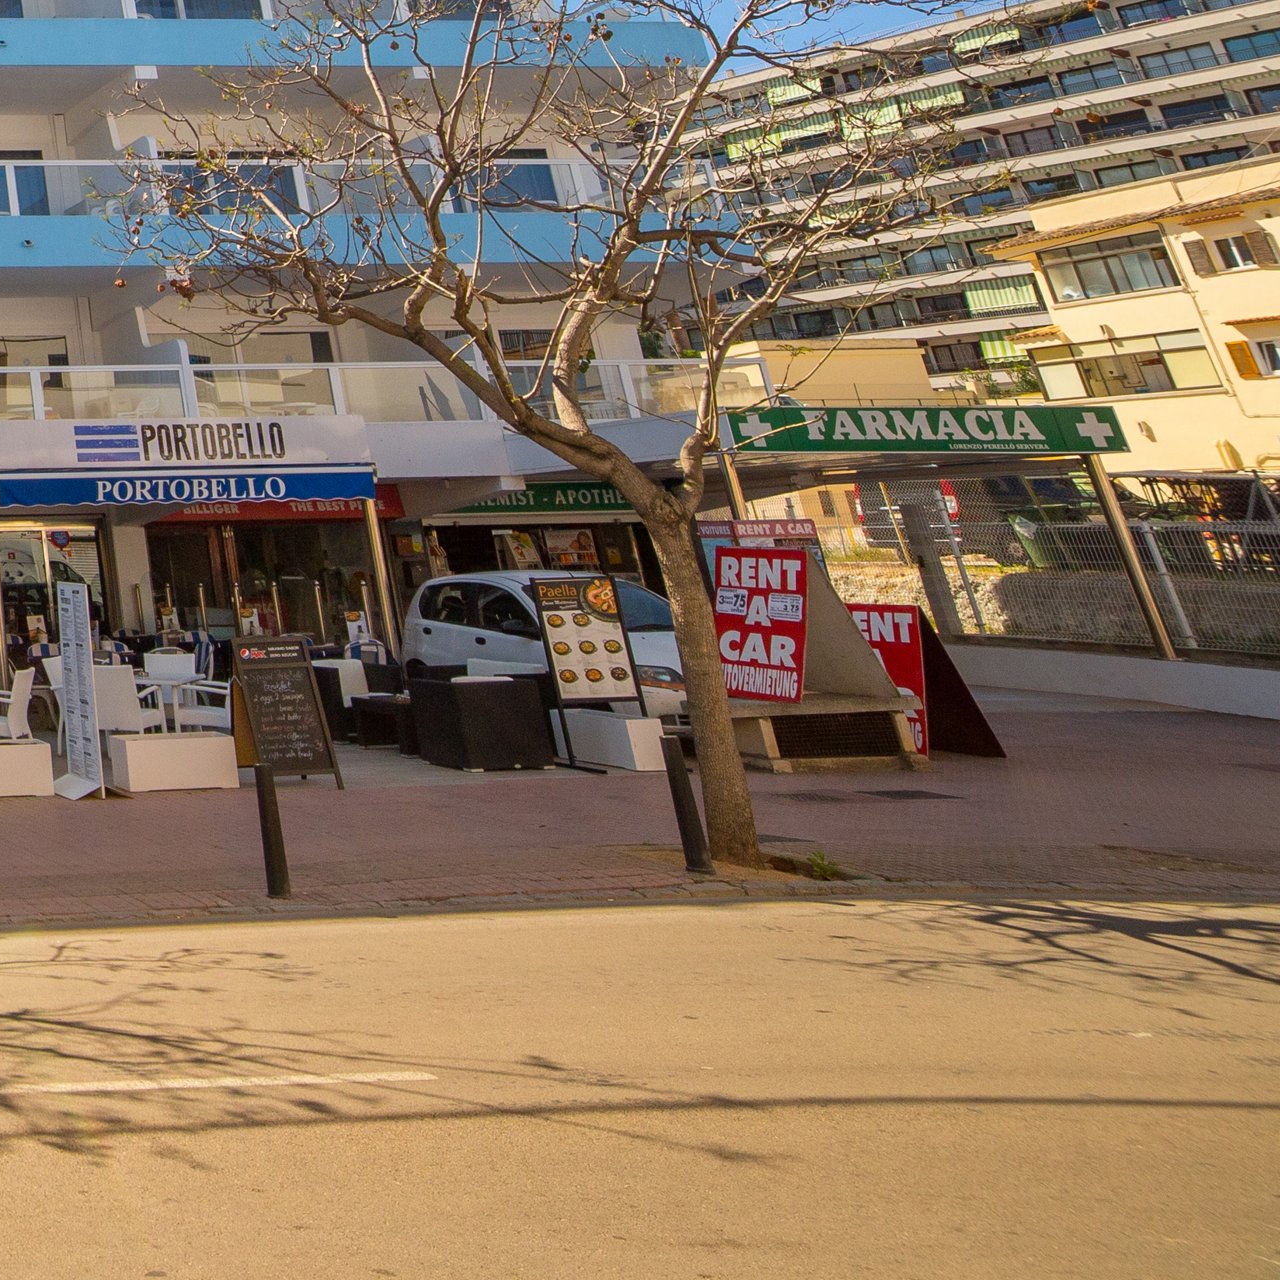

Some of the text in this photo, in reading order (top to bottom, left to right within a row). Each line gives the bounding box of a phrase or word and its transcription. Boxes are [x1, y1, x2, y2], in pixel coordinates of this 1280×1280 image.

[801, 410, 1046, 442] FARMACIA
[141, 421, 286, 461] PORTOBELLO
[96, 476, 286, 502] PORTOBELLO
[555, 489, 628, 505] APOTHE
[289, 502, 315, 512] THE
[317, 500, 346, 512] BEST
[737, 523, 814, 536] RENT A CAR
[720, 556, 802, 591] RENT
[538, 584, 577, 598] Paella
[733, 593, 746, 608] 75
[744, 595, 771, 627] A
[851, 611, 913, 644] ENT
[719, 630, 797, 668] CAR
